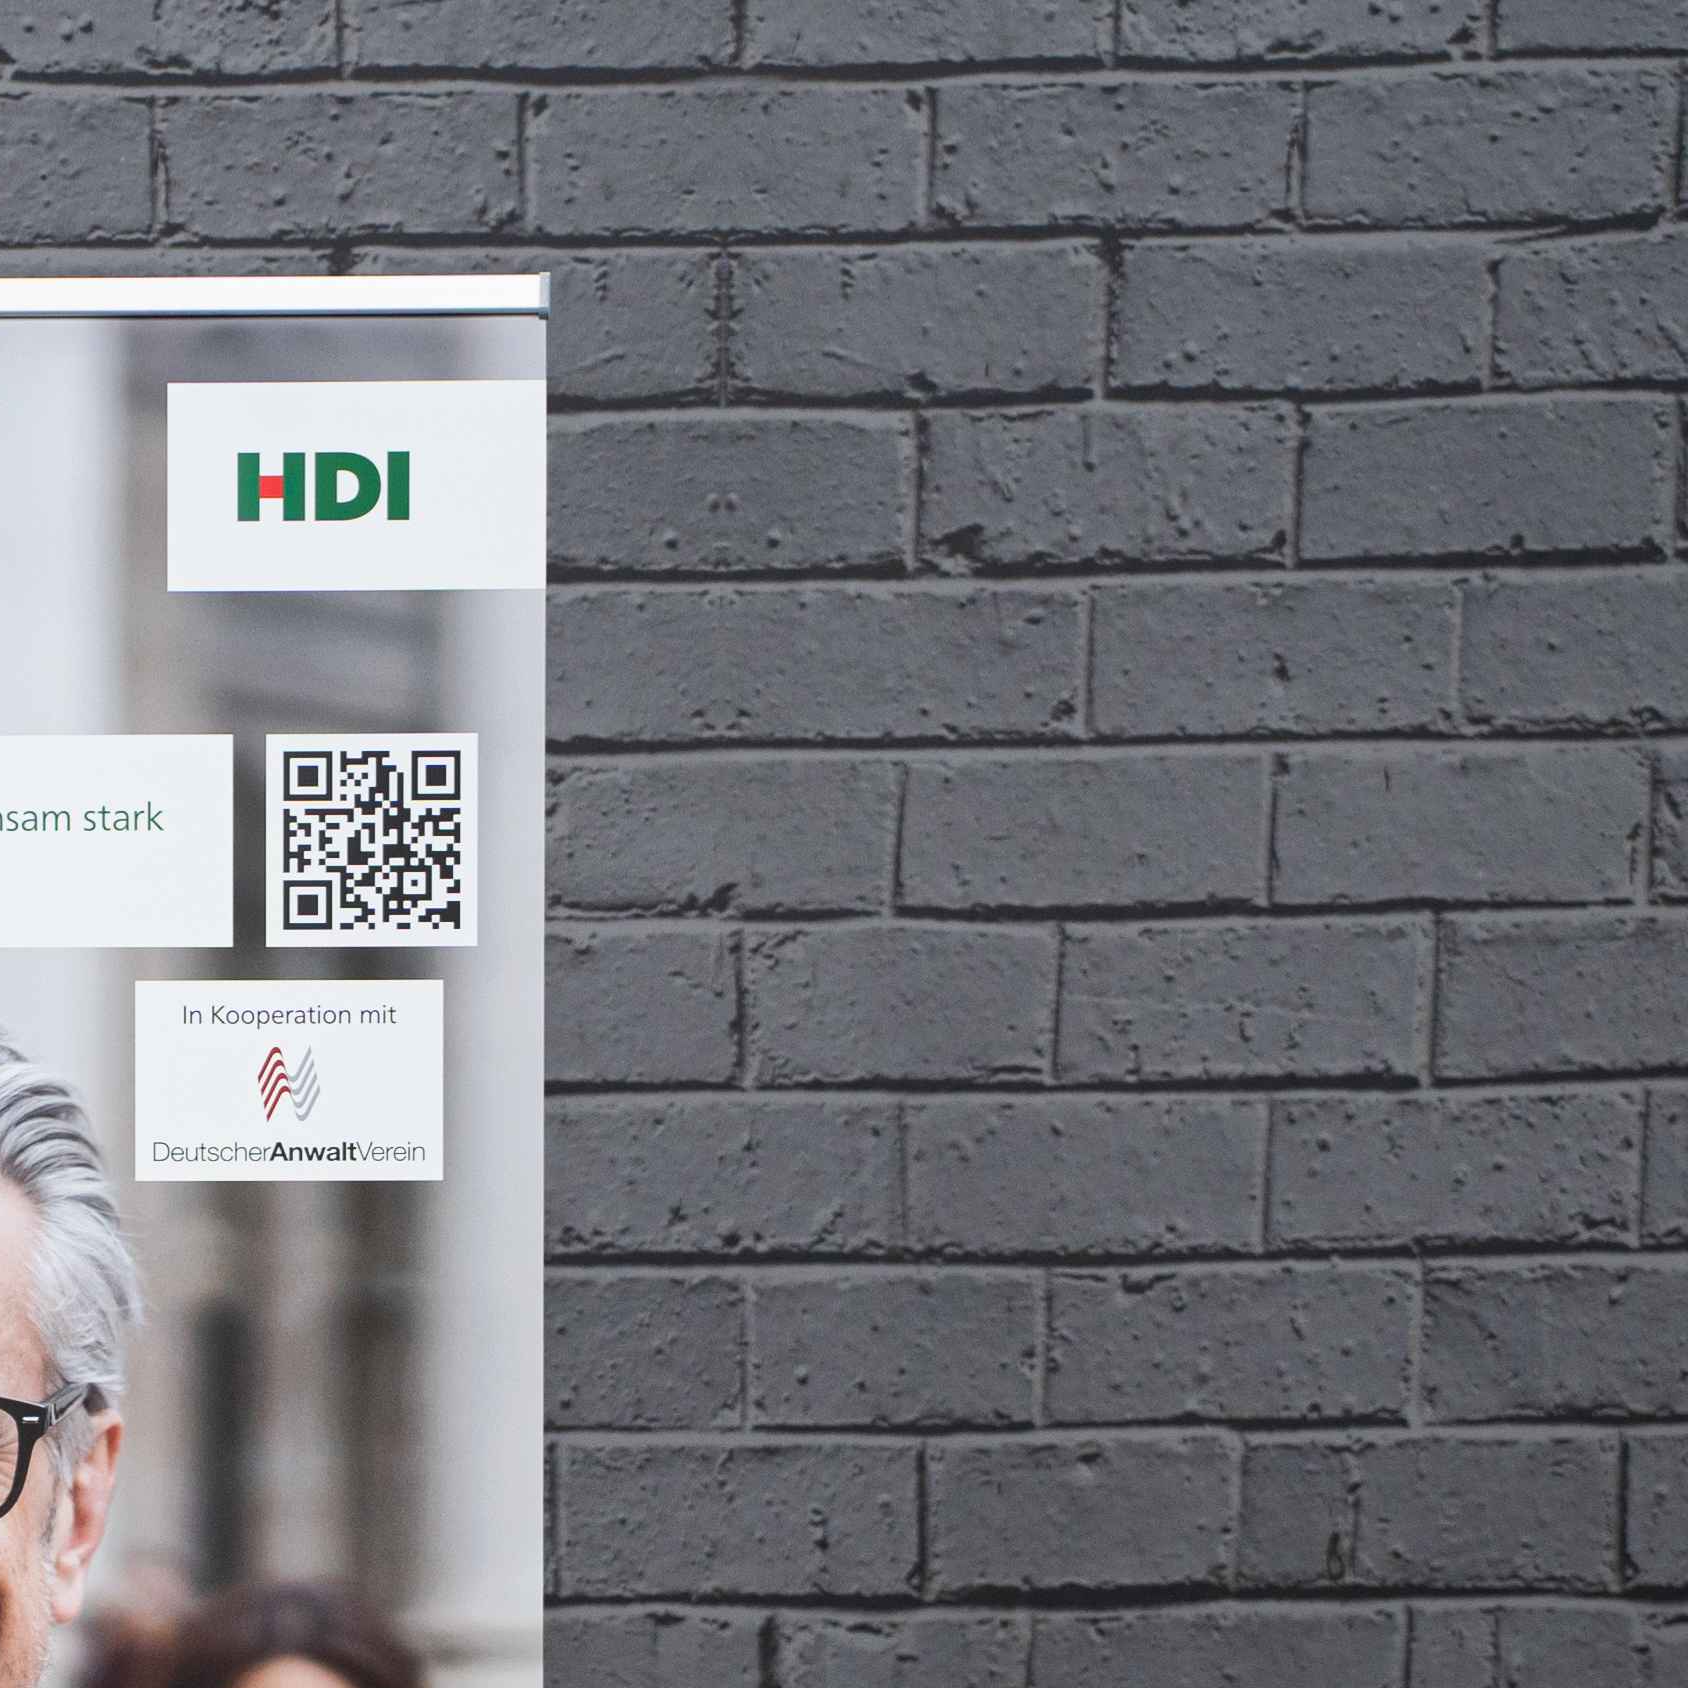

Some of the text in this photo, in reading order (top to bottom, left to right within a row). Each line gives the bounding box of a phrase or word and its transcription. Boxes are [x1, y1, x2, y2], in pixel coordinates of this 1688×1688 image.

[237, 450, 411, 522] HDI
[82, 801, 165, 832] stark
[182, 1004, 398, 1029] In Kooperation mit
